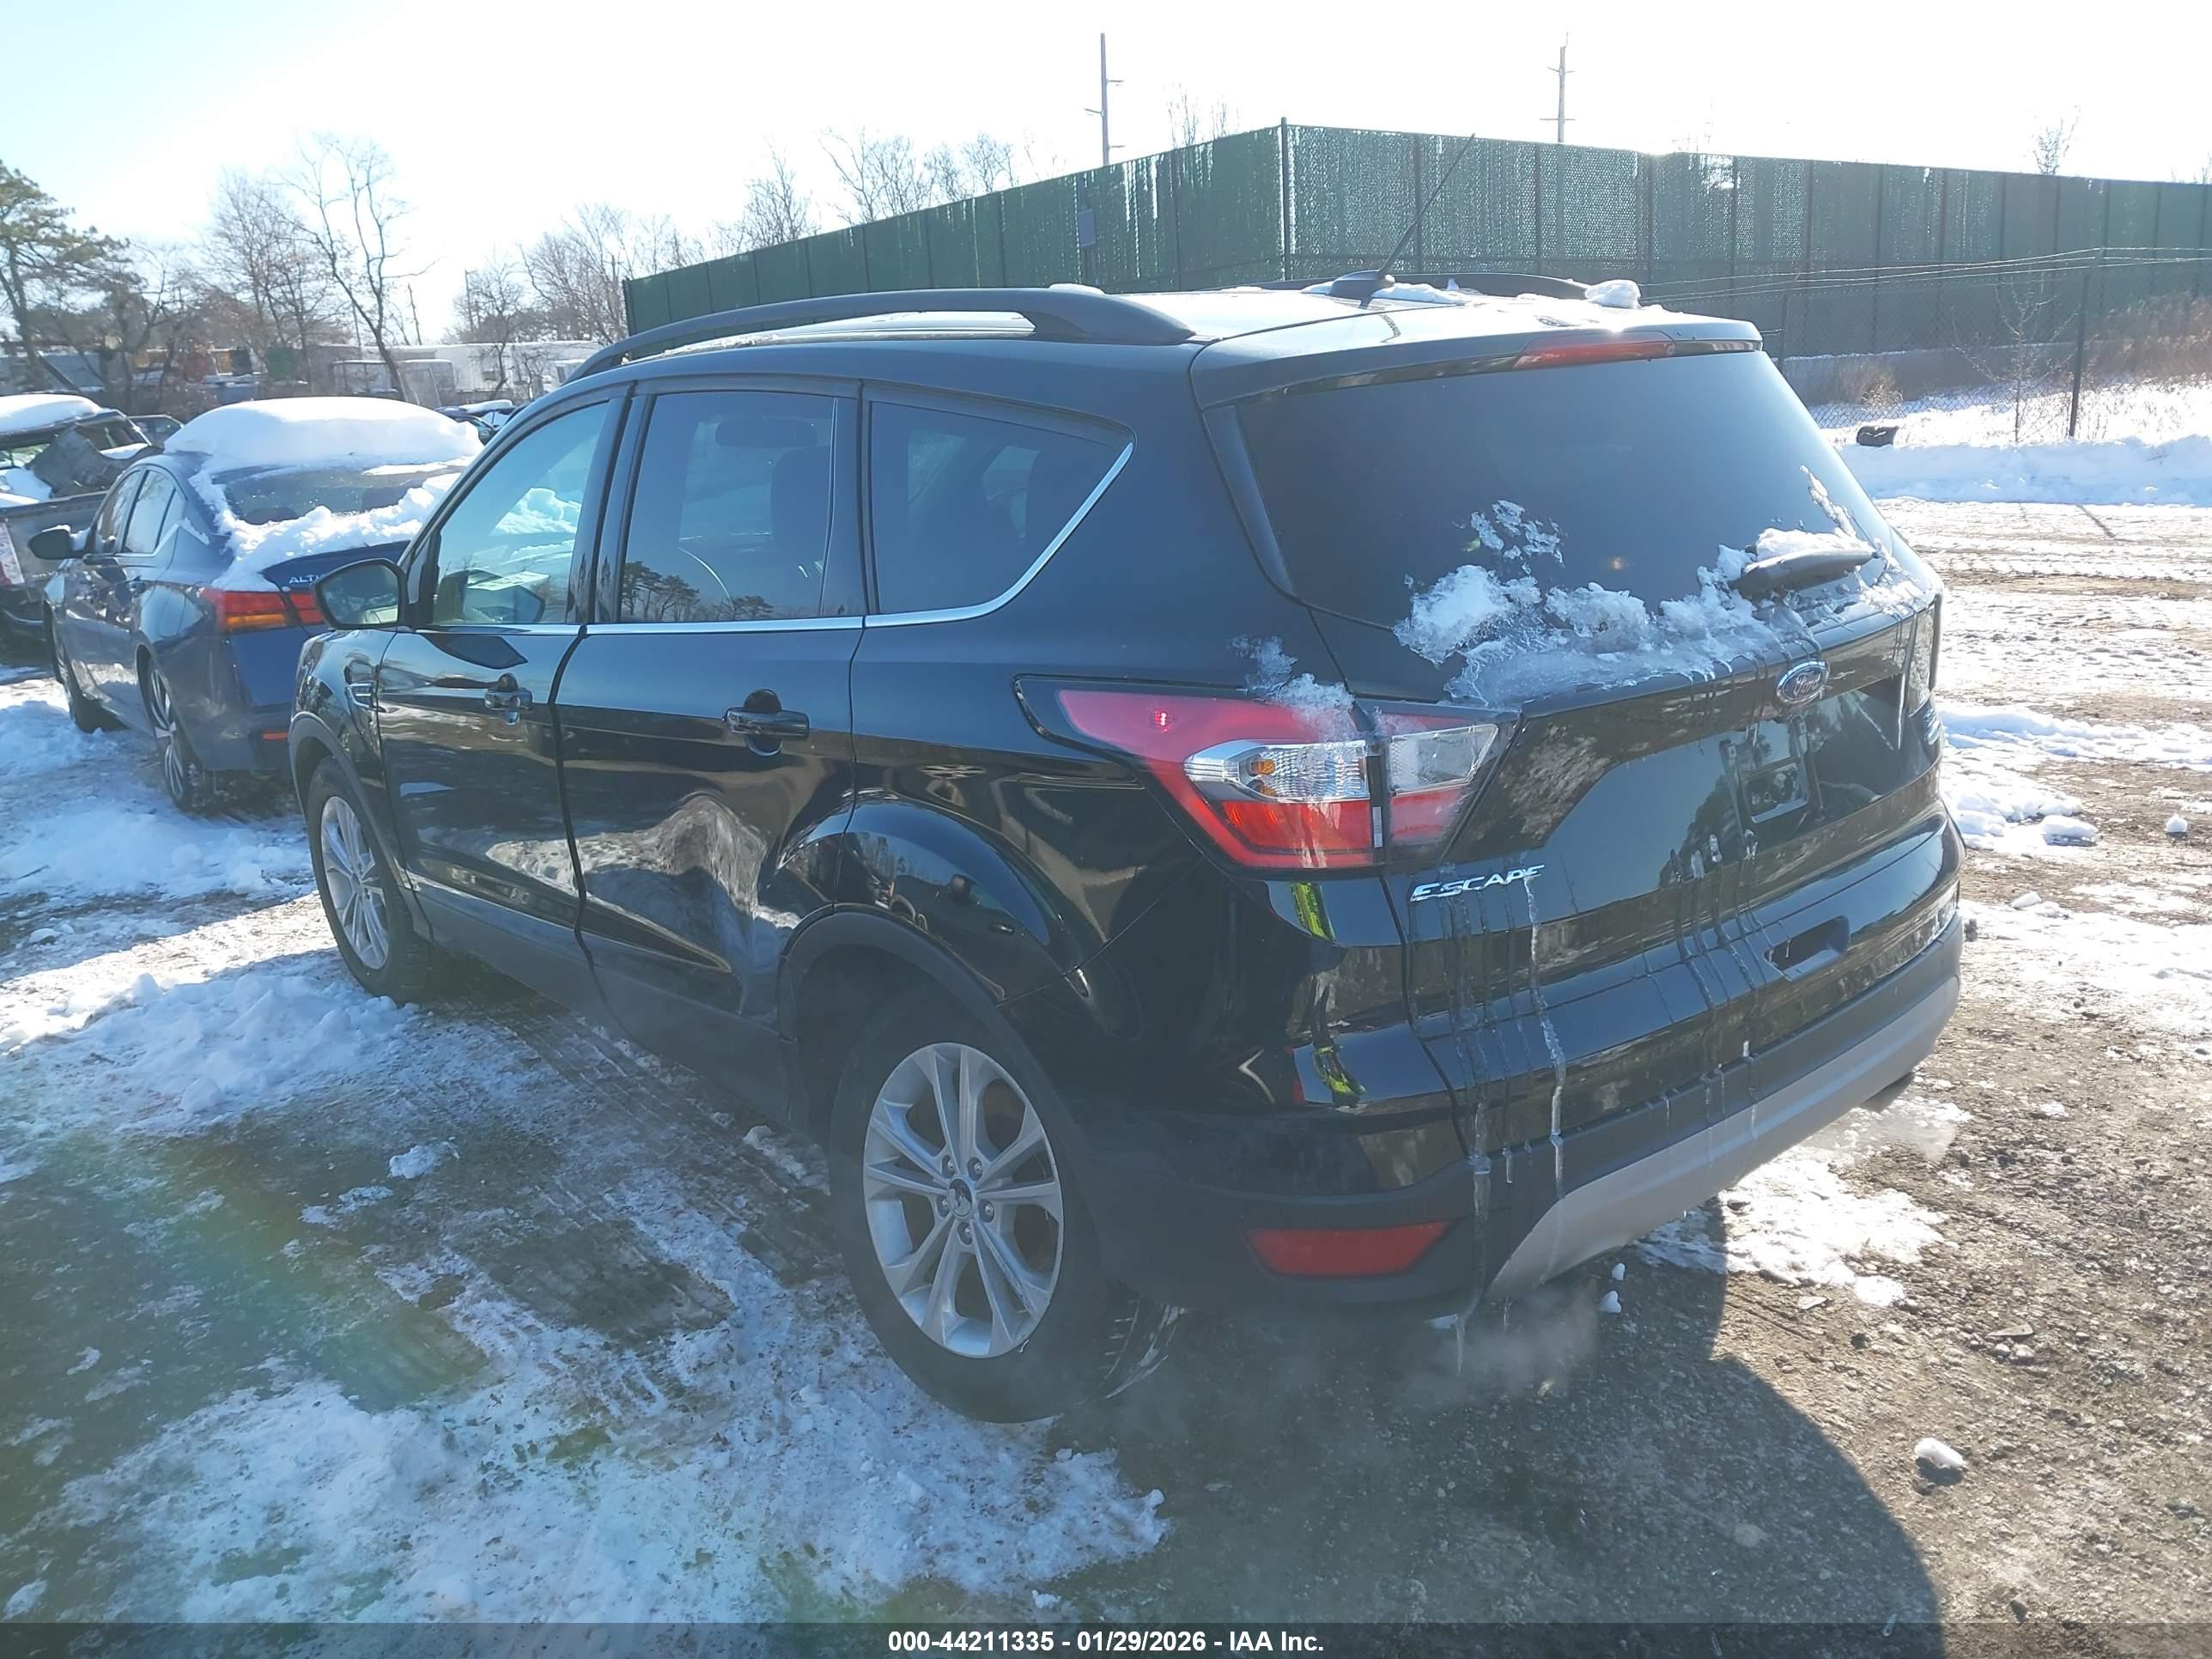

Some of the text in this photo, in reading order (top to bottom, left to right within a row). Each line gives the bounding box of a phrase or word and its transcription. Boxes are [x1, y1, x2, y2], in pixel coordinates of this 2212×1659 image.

[289, 574, 324, 584] ALTI
[1793, 671, 1821, 696] Ford
[1410, 864, 1546, 902] ESCAPE
